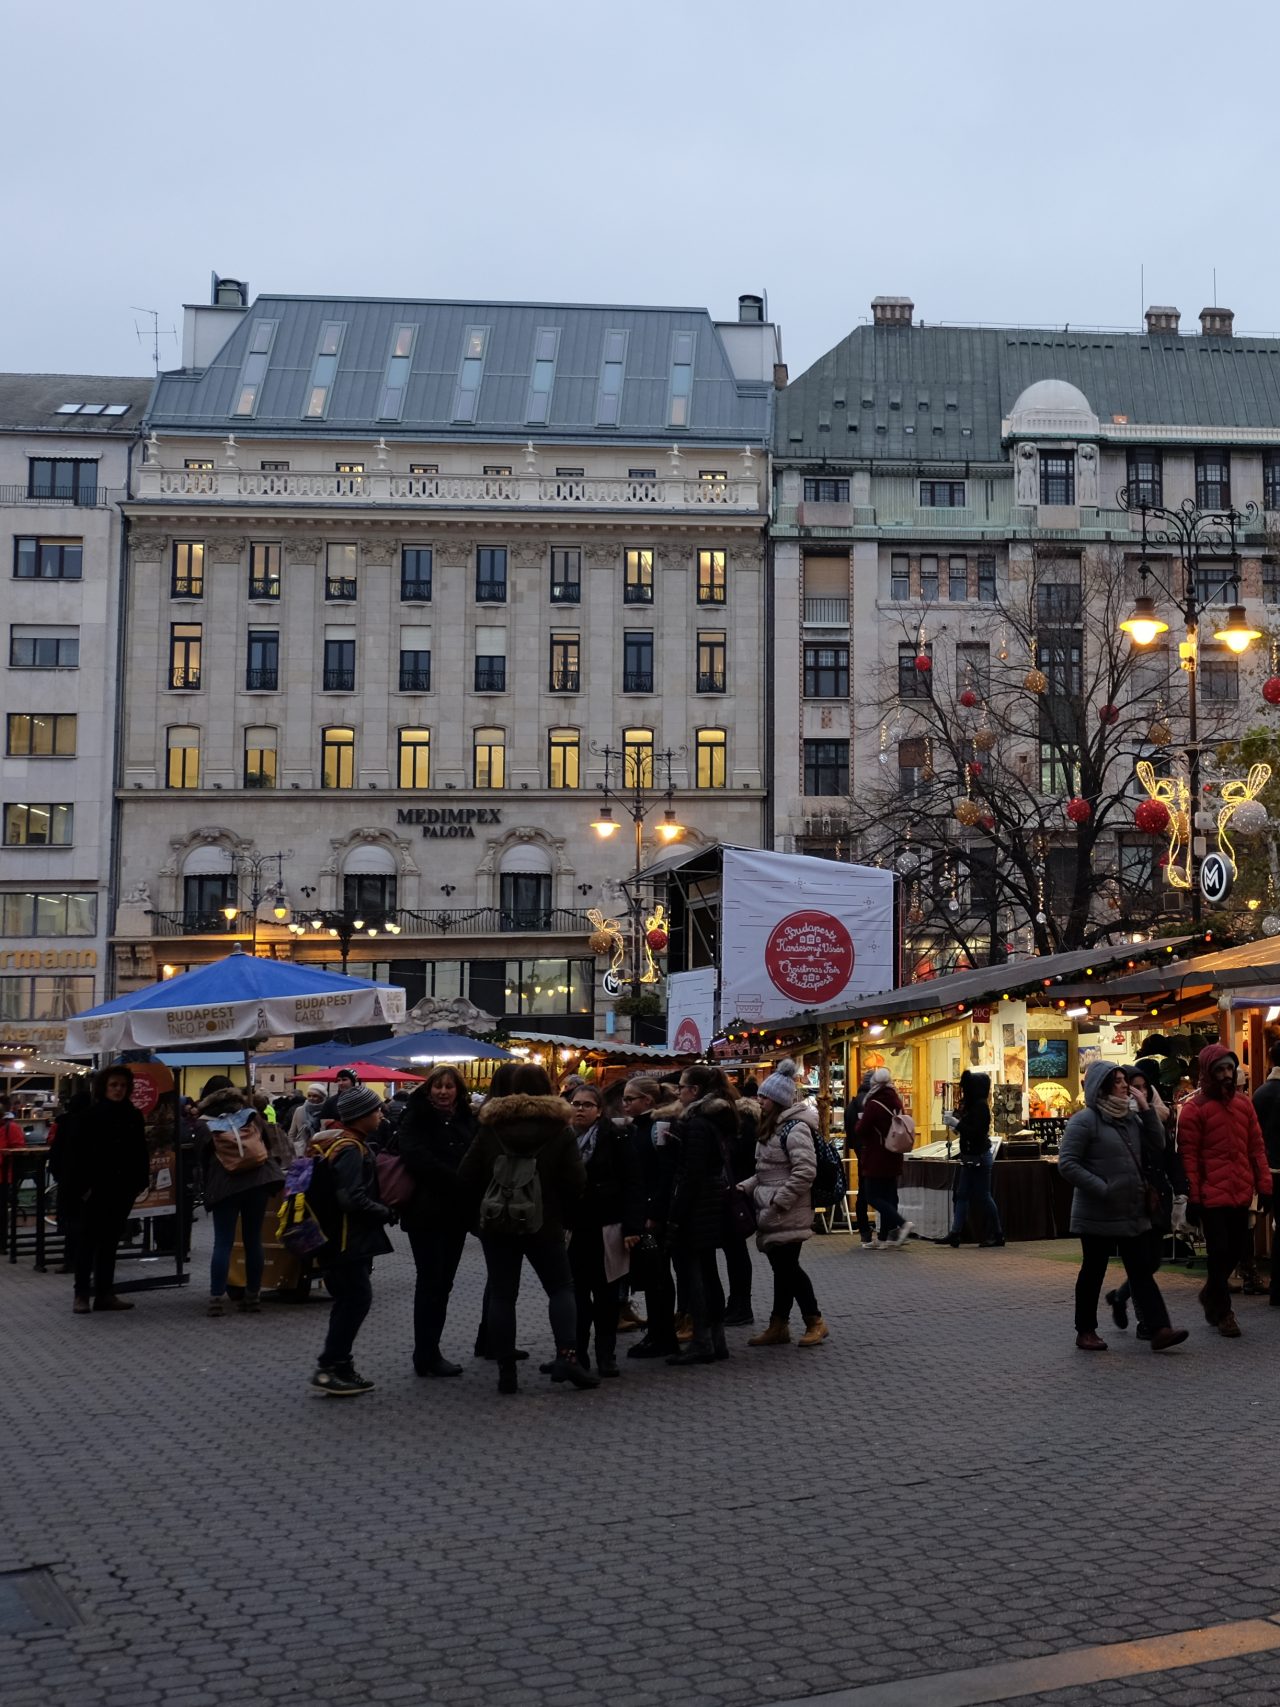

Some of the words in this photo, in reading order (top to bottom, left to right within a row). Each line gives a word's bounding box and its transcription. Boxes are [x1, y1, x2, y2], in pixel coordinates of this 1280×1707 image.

[397, 808, 502, 824] MEDIMPEX
[423, 826, 475, 838] PALOTA
[779, 960, 823, 974] Christmas
[823, 961, 841, 975] Fair
[785, 972, 834, 992] Budapest
[295, 994, 354, 1010] BUDAPEST
[167, 1006, 235, 1023] BUDAPEST
[295, 1009, 325, 1022] CARD
[168, 1021, 195, 1035] INFO
